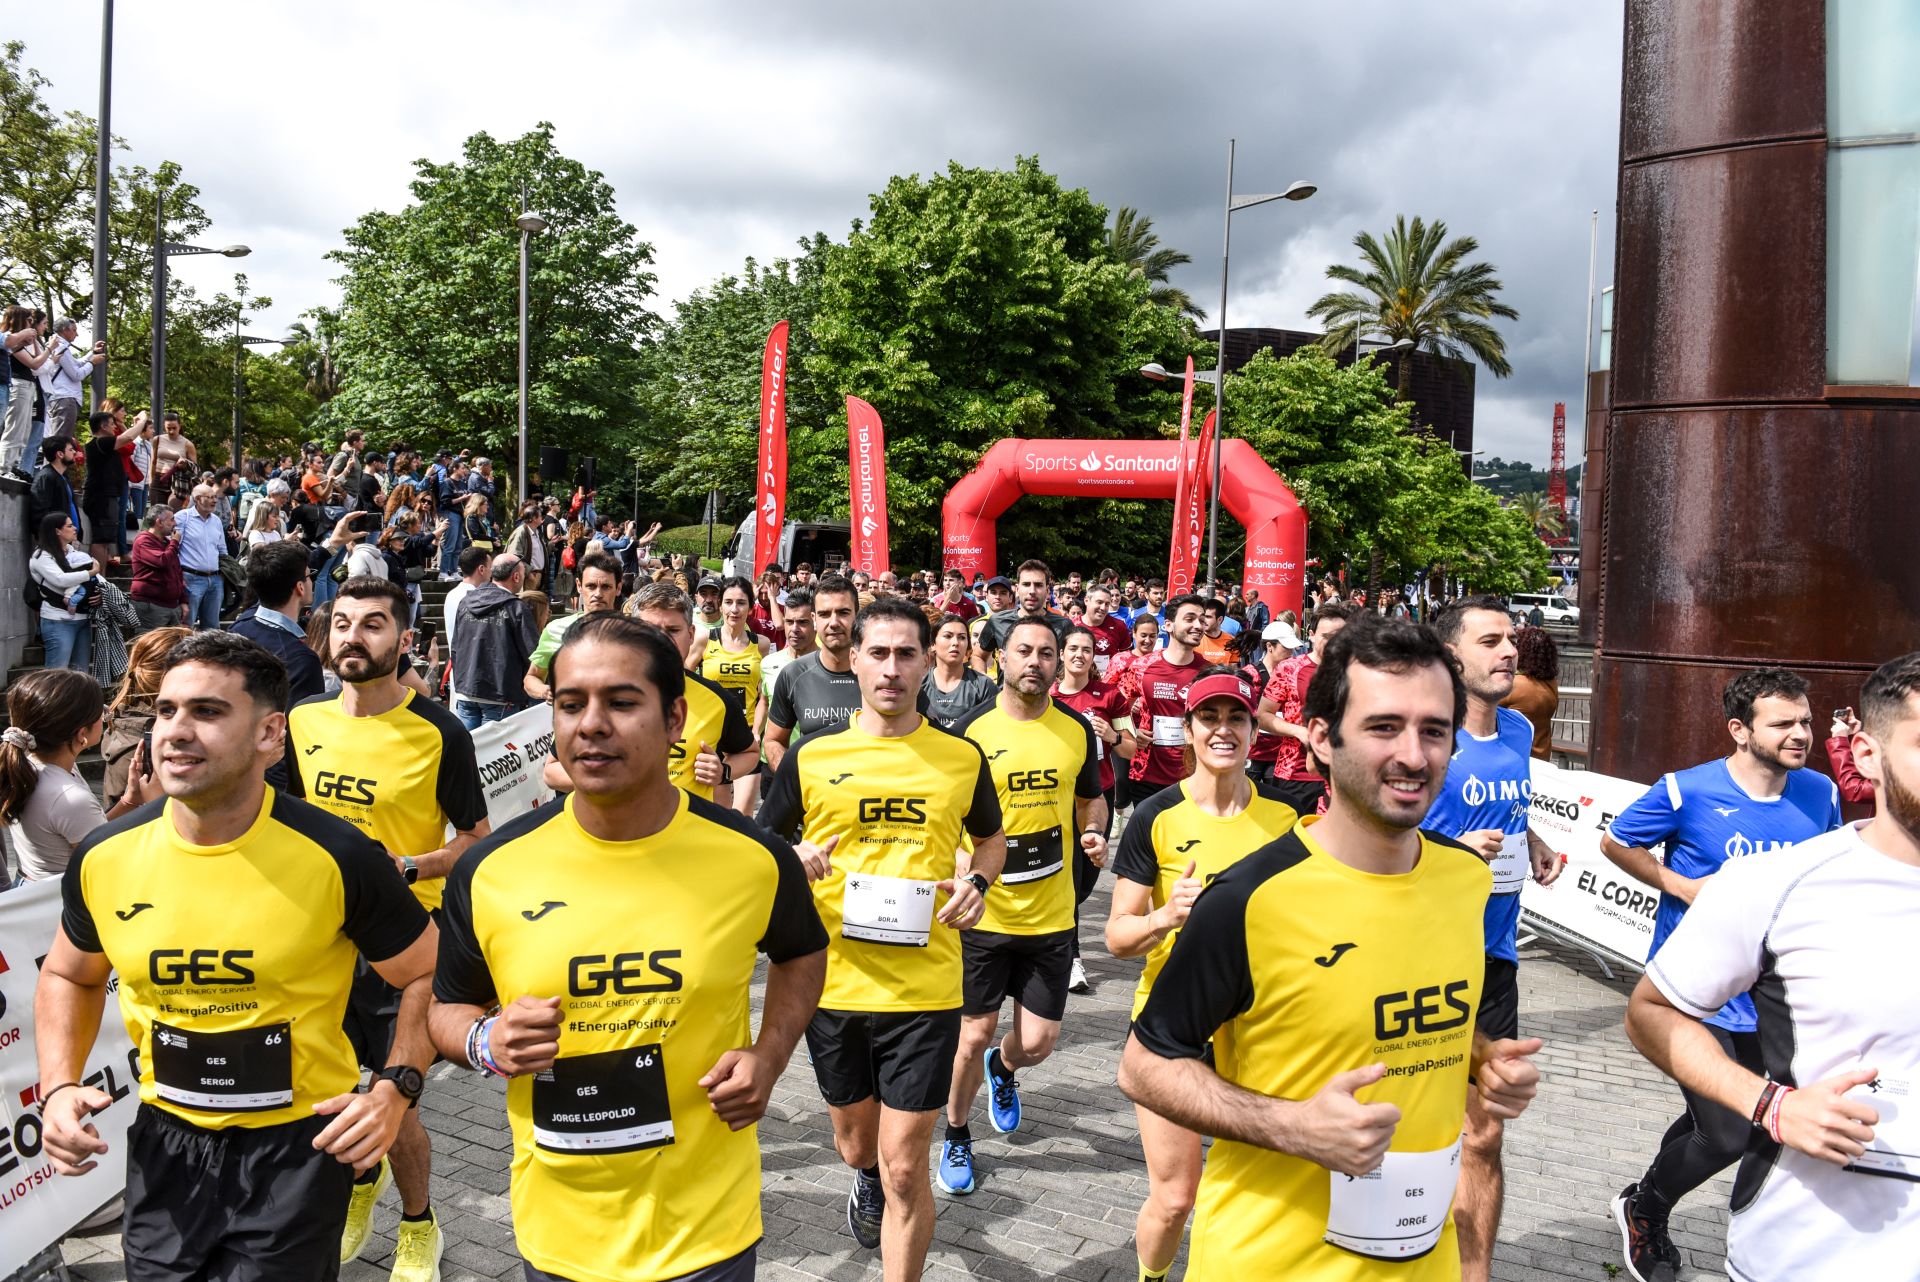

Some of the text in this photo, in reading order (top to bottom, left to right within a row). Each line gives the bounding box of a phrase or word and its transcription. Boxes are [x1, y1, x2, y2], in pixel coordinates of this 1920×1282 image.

[1024, 453, 1196, 474] Sports Santandr
[947, 534, 970, 543] Sports
[1256, 545, 1284, 556] Sports
[1253, 560, 1296, 569] Santander
[720, 663, 751, 675] GES
[479, 752, 522, 785] CORREO
[1008, 769, 1059, 792] GES
[314, 771, 378, 806] GES
[859, 797, 927, 825] GES
[1529, 792, 1579, 821] RREO
[859, 836, 924, 846] #EnergiaPositiva
[1577, 870, 1658, 921] EL CORR
[877, 915, 898, 924] BORJA
[149, 948, 255, 985] GES
[568, 949, 683, 998] GES
[219, 985, 257, 994] SERVICES
[159, 1001, 258, 1017] #EnergiaPositiva
[569, 997, 681, 1009] GLOBAL ENERGY SERVICES
[1374, 979, 1470, 1041] GES
[569, 1017, 677, 1033] #EnergiaPositiva
[265, 1033, 282, 1046] 66
[1374, 1030, 1468, 1054] GLOBAL ENERGY SERVICES
[206, 1057, 227, 1065] GES
[635, 1054, 653, 1068] 66
[1382, 1053, 1464, 1078] nergiaPositiva
[200, 1077, 235, 1086] SERGIO
[576, 1085, 598, 1096] GES
[551, 1107, 636, 1123] JORGE LEOPOLDO
[1405, 1187, 1424, 1197] GES
[1396, 1215, 1428, 1227] JORGE
